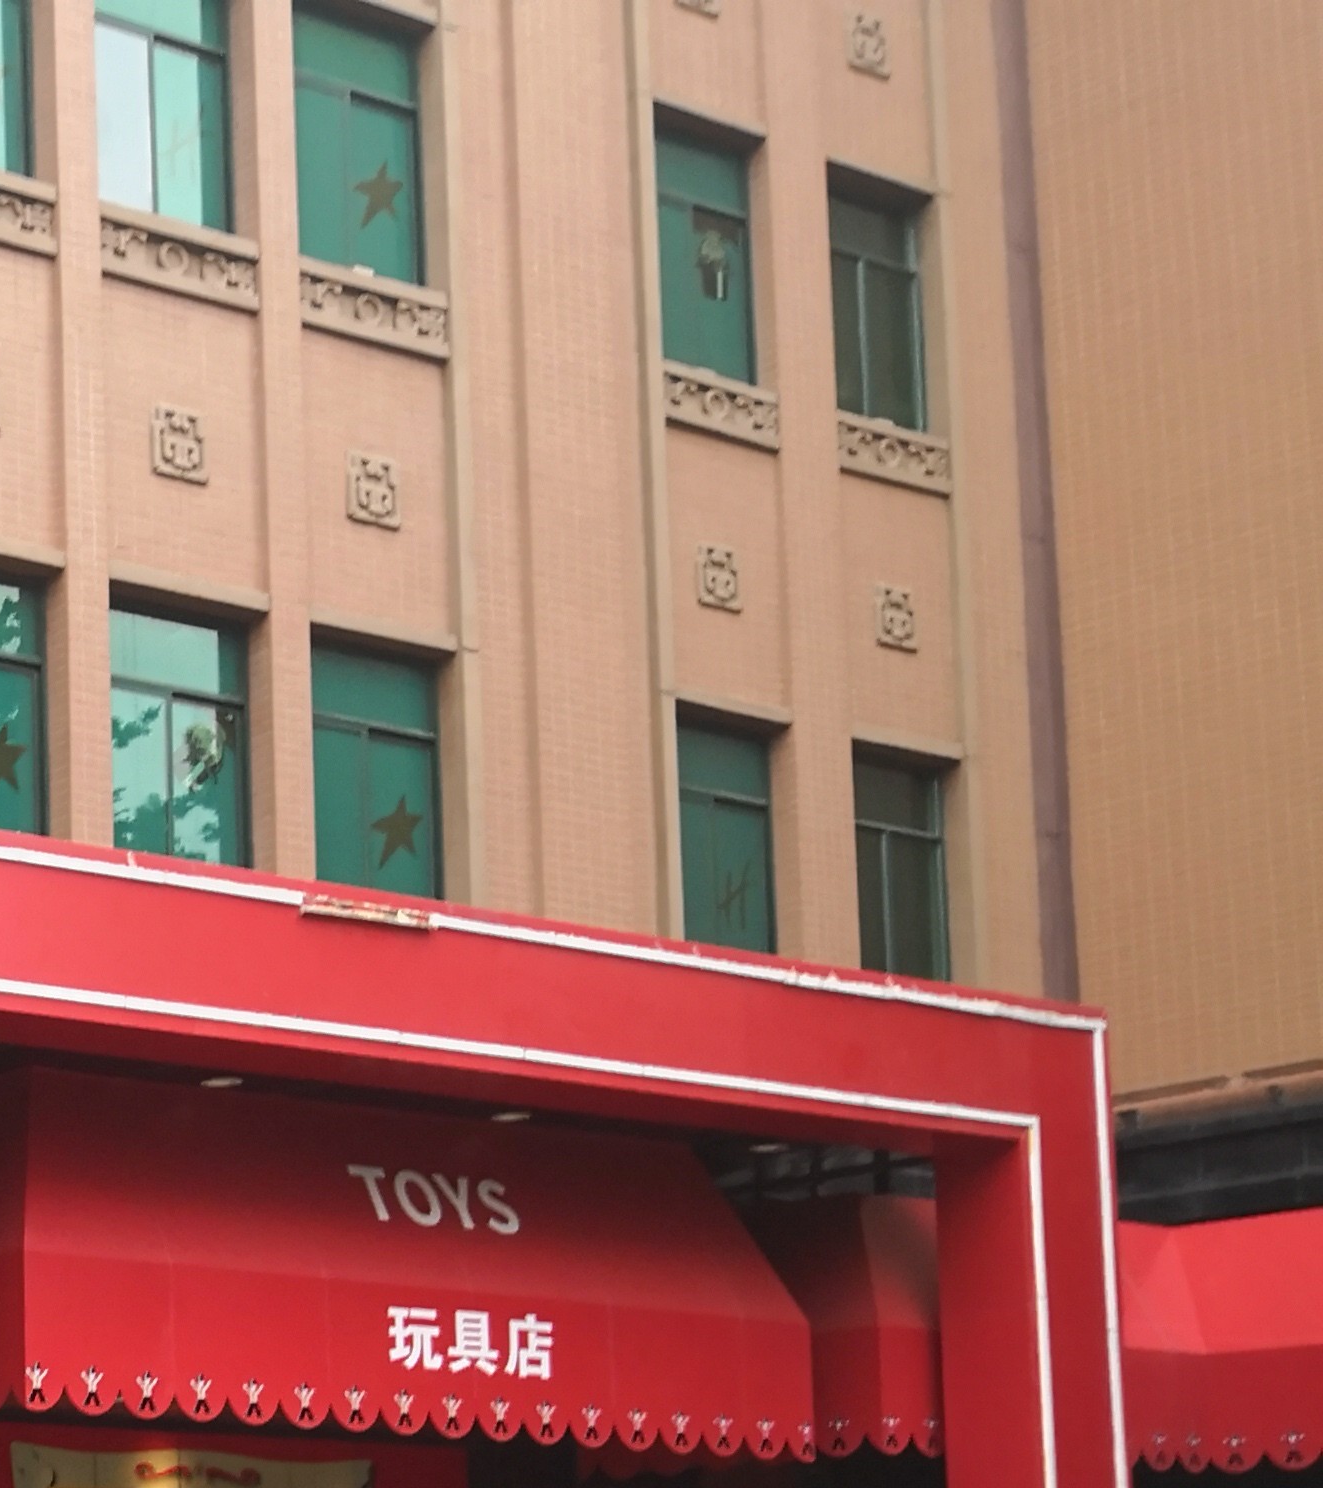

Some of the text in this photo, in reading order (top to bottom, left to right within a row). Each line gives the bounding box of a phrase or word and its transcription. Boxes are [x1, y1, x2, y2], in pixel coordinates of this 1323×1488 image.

[346, 1163, 521, 1236] TOYS
[386, 1305, 555, 1381] 玩具店
